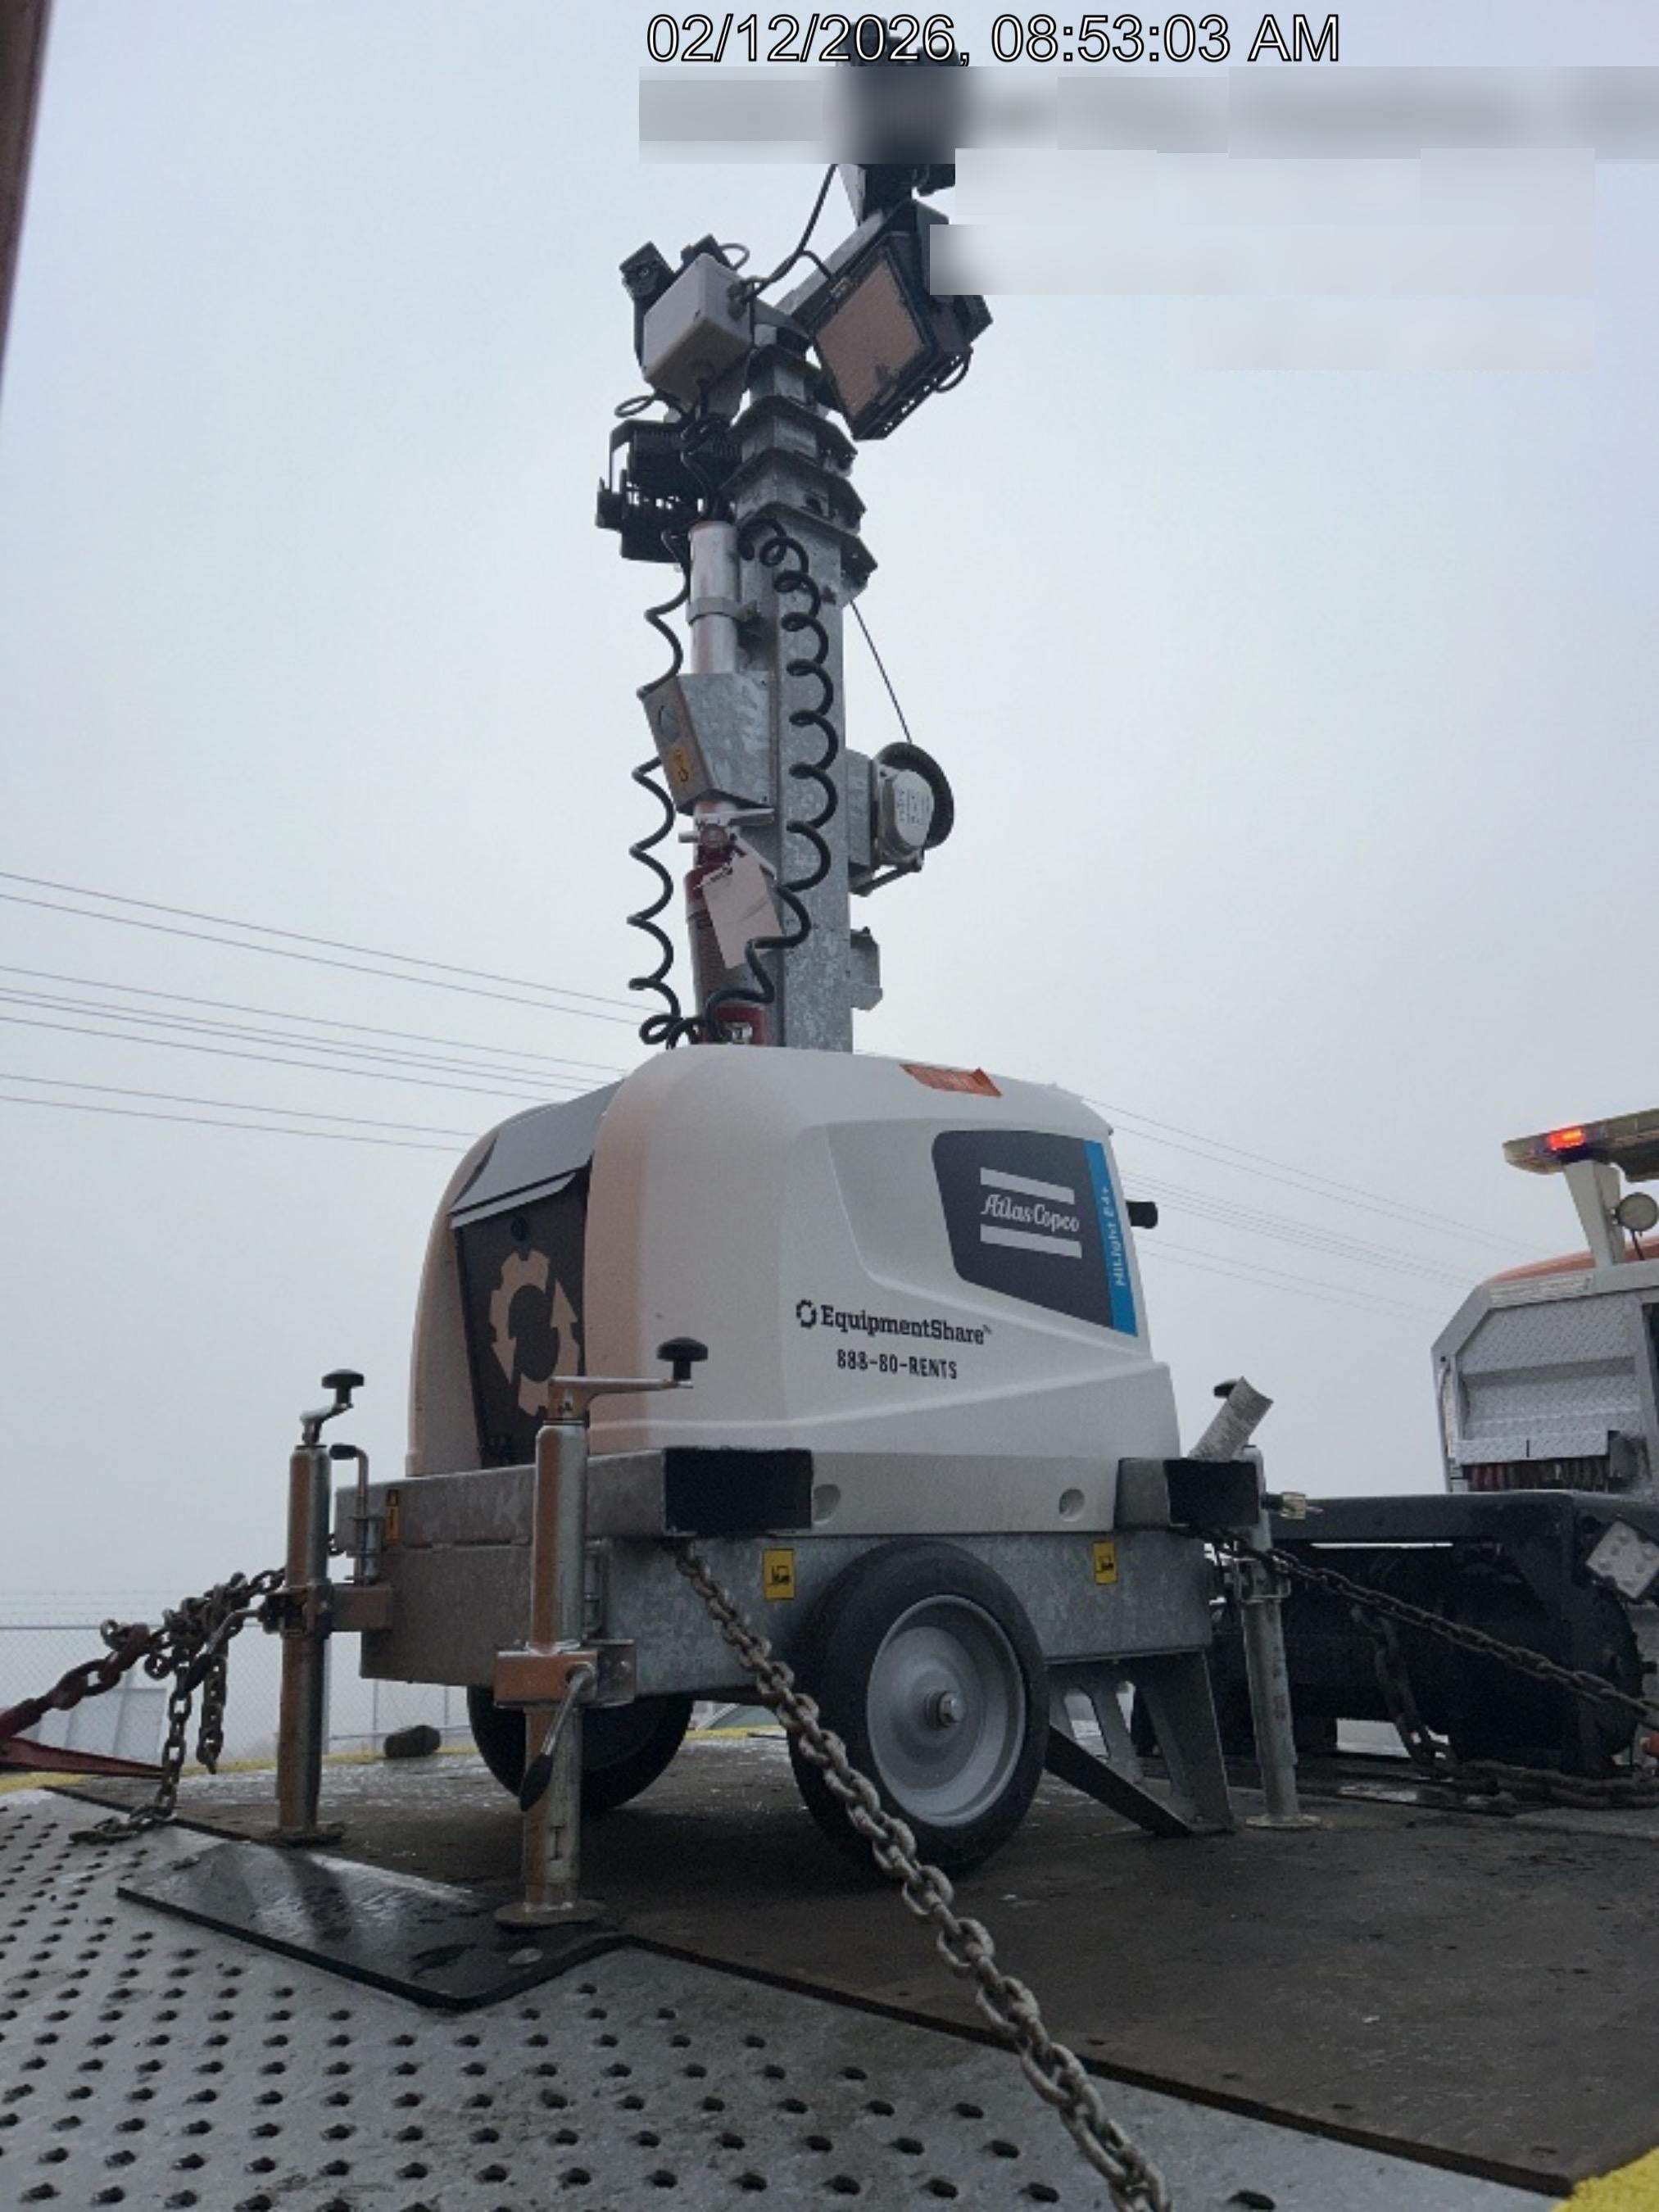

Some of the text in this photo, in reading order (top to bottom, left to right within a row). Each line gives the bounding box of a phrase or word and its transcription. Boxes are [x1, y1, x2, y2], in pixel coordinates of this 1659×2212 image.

[980, 1194, 1080, 1232] Atlas Copco
[820, 1304, 984, 1344] EquipmentShare
[837, 1349, 958, 1380] 888-80-RENTS
